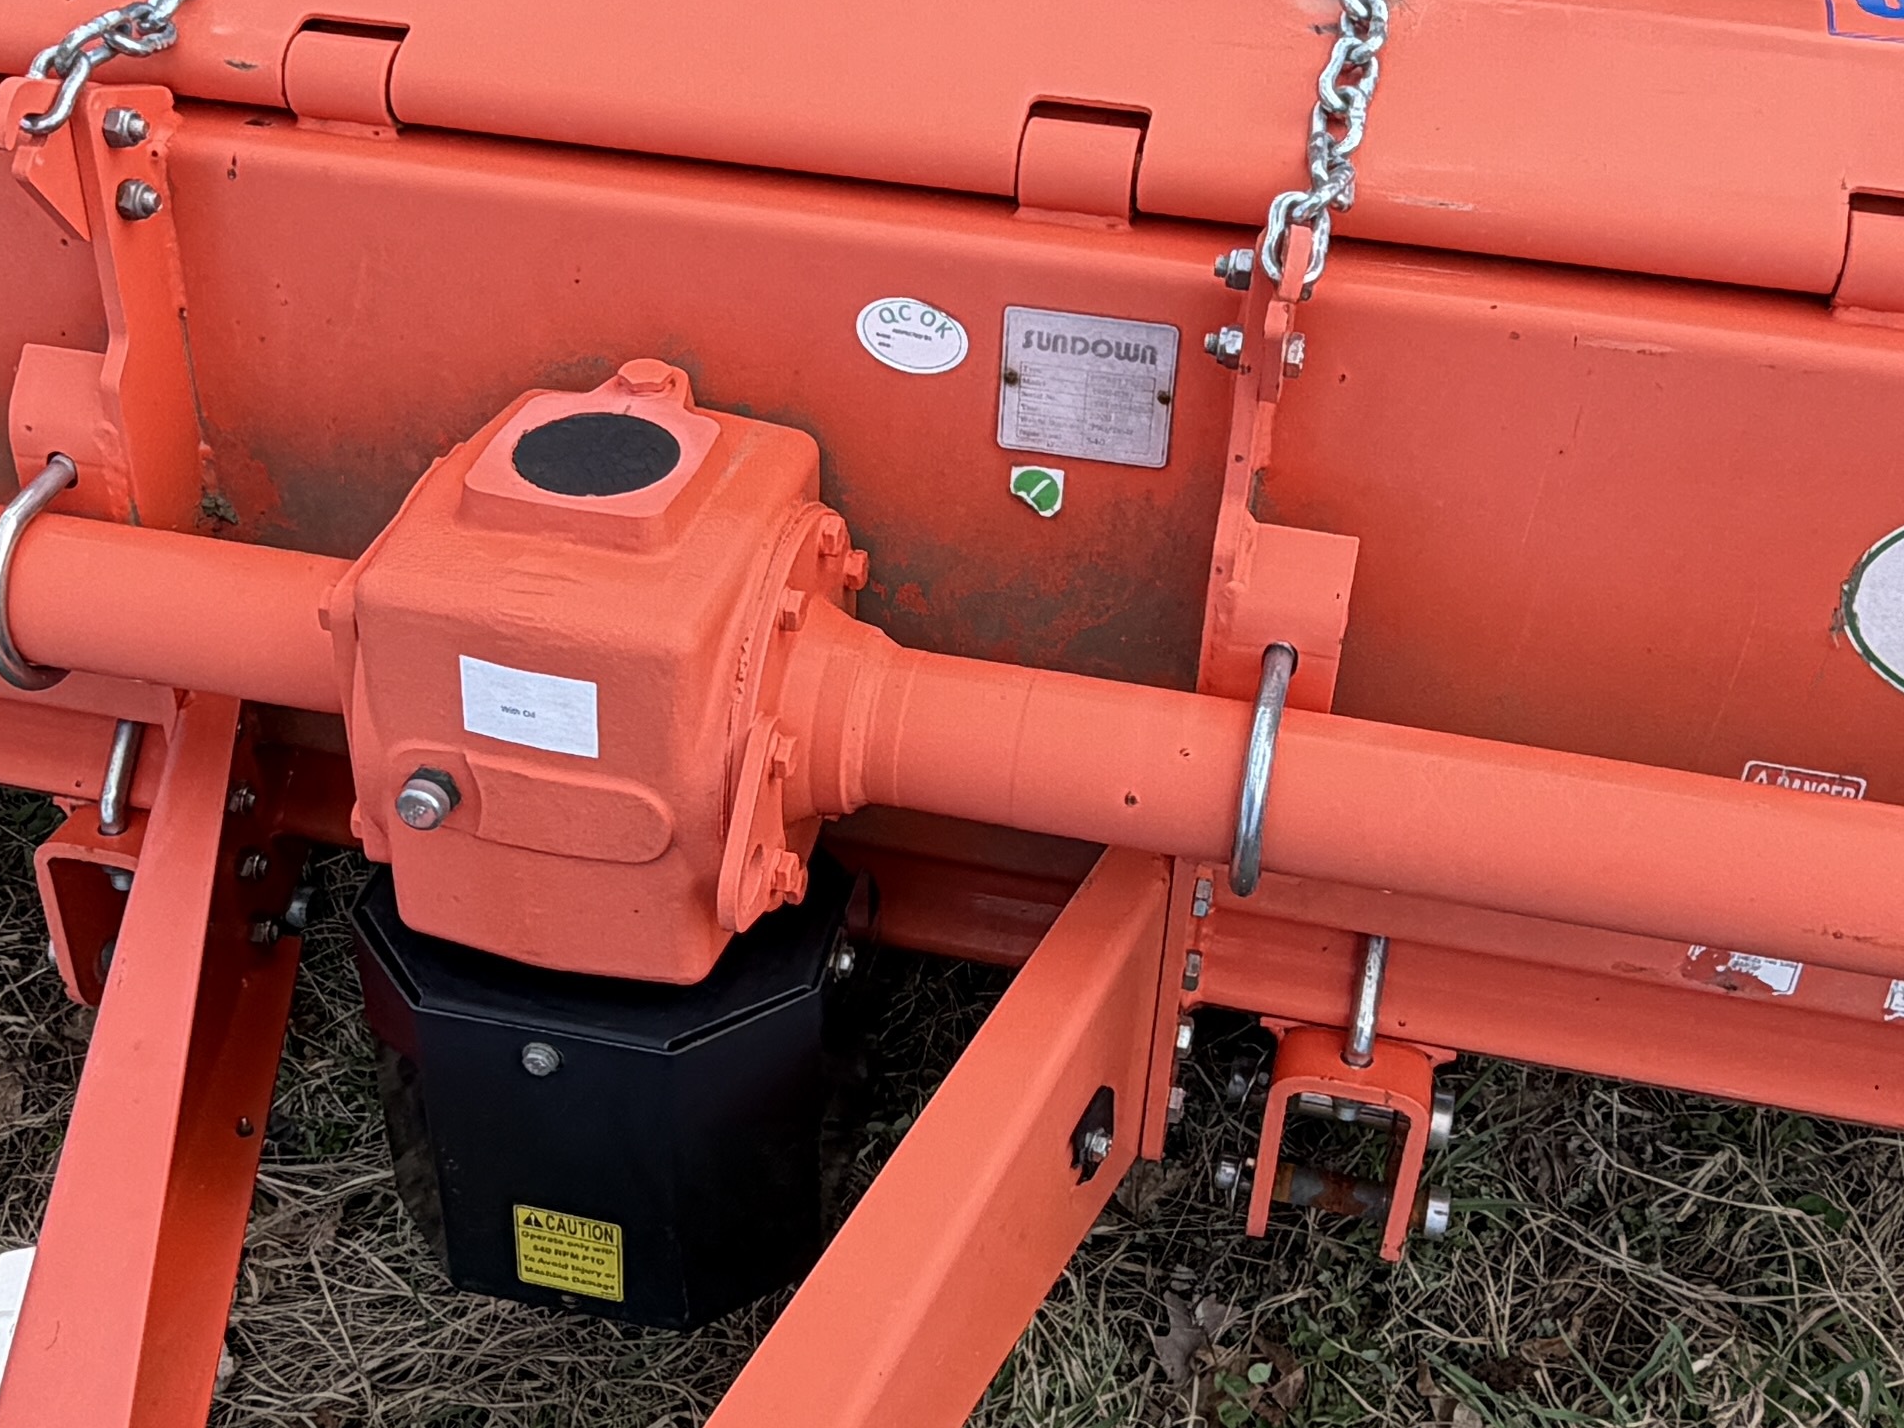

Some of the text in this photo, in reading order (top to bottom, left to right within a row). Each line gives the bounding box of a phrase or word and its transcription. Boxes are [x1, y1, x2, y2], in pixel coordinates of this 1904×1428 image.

[878, 304, 912, 324] QC
[919, 310, 953, 340] OK
[1021, 329, 1158, 365] SUNDOWN
[545, 1214, 614, 1244] CAUTION
[521, 1230, 564, 1245] Operate
[566, 1241, 590, 1252] only
[537, 1257, 569, 1270] Avoid
[554, 1248, 580, 1261] RPM
[581, 1254, 605, 1266] PTO
[571, 1276, 615, 1291] Damage
